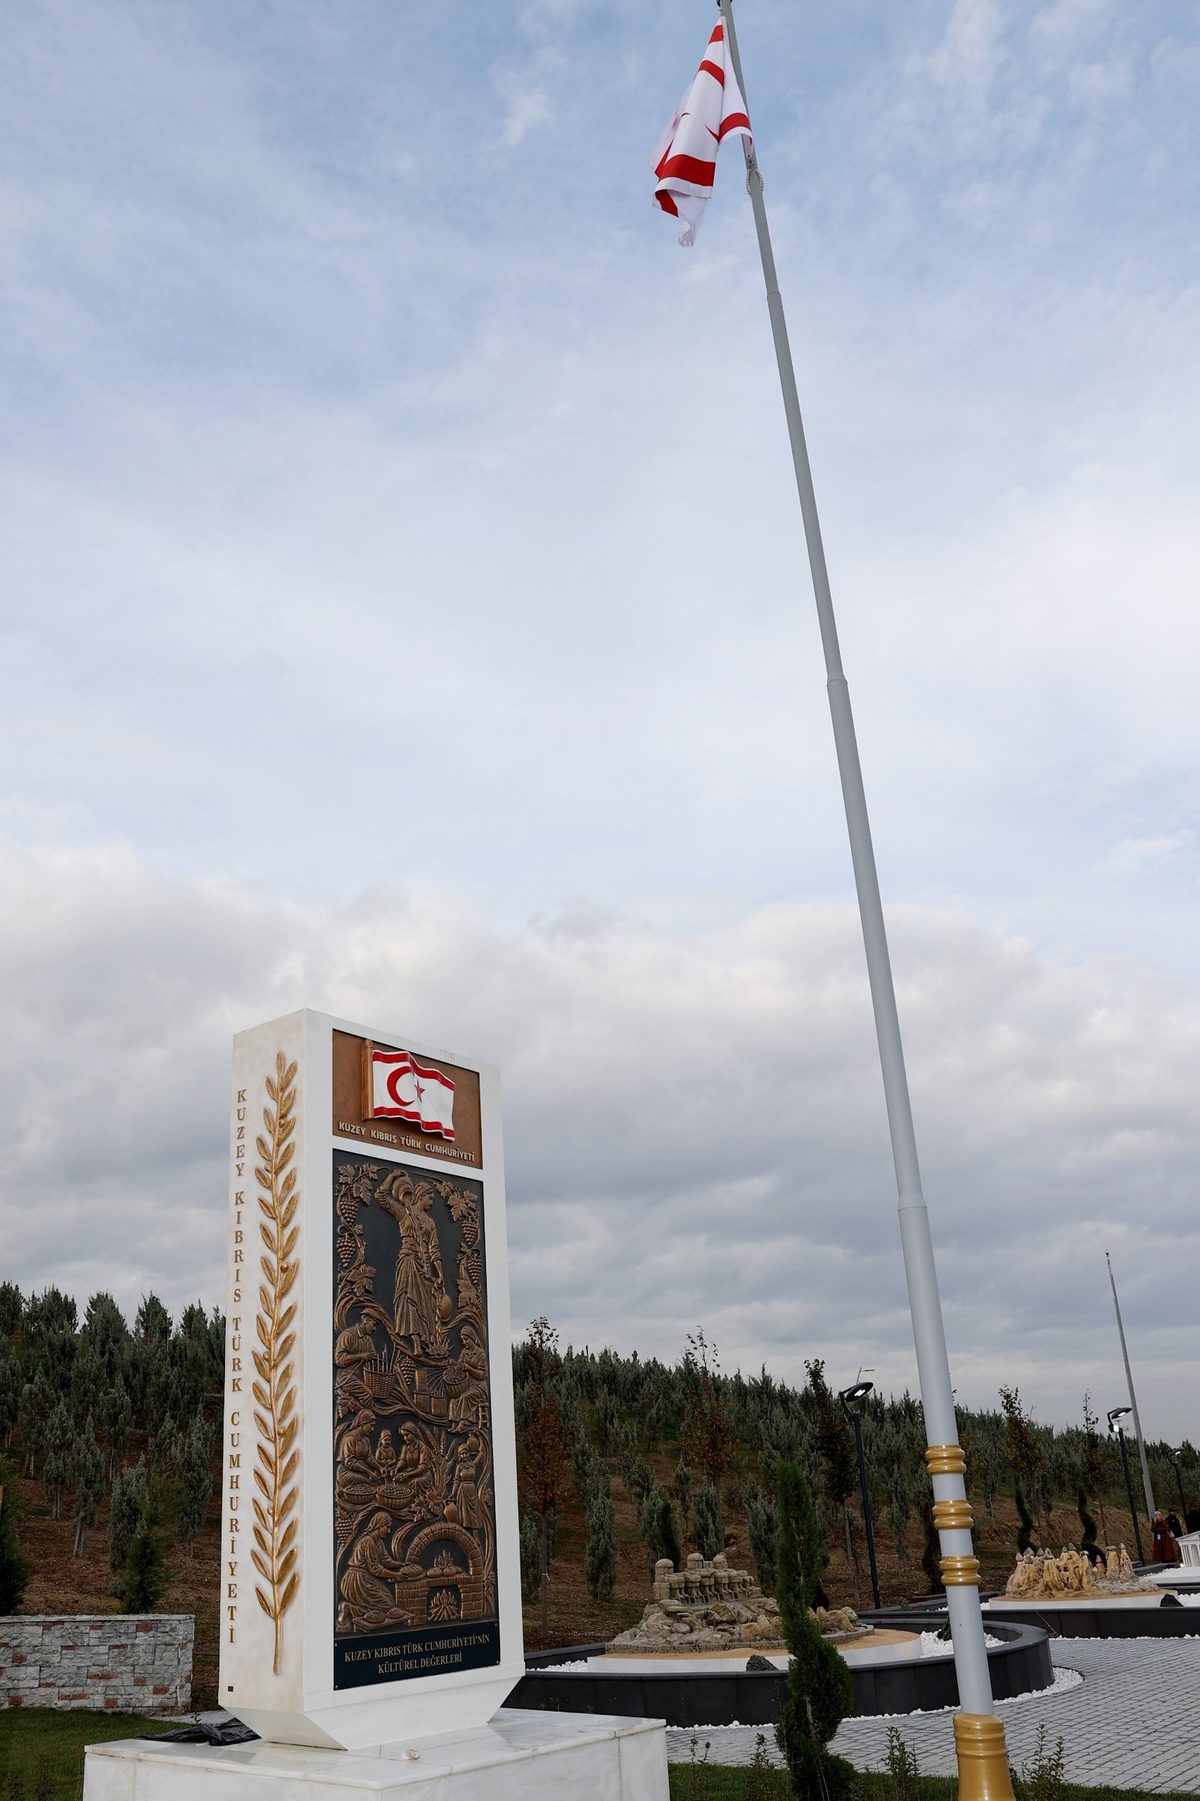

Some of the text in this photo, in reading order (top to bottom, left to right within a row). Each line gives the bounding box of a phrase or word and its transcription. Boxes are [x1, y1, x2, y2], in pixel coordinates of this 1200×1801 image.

[339, 1121, 475, 1162] KUZEY KIBRIS TÜRK CUMHURİYETİ
[227, 1088, 247, 1644] KUZEY KIBRIS TÜRK CUMHURİYETİ
[344, 1632, 490, 1662] KUZEY KIBRIS TÜRK CUMHURİYETİ'NİN
[378, 1651, 462, 1674] KÜLTÜREL DEĞERLERİ
